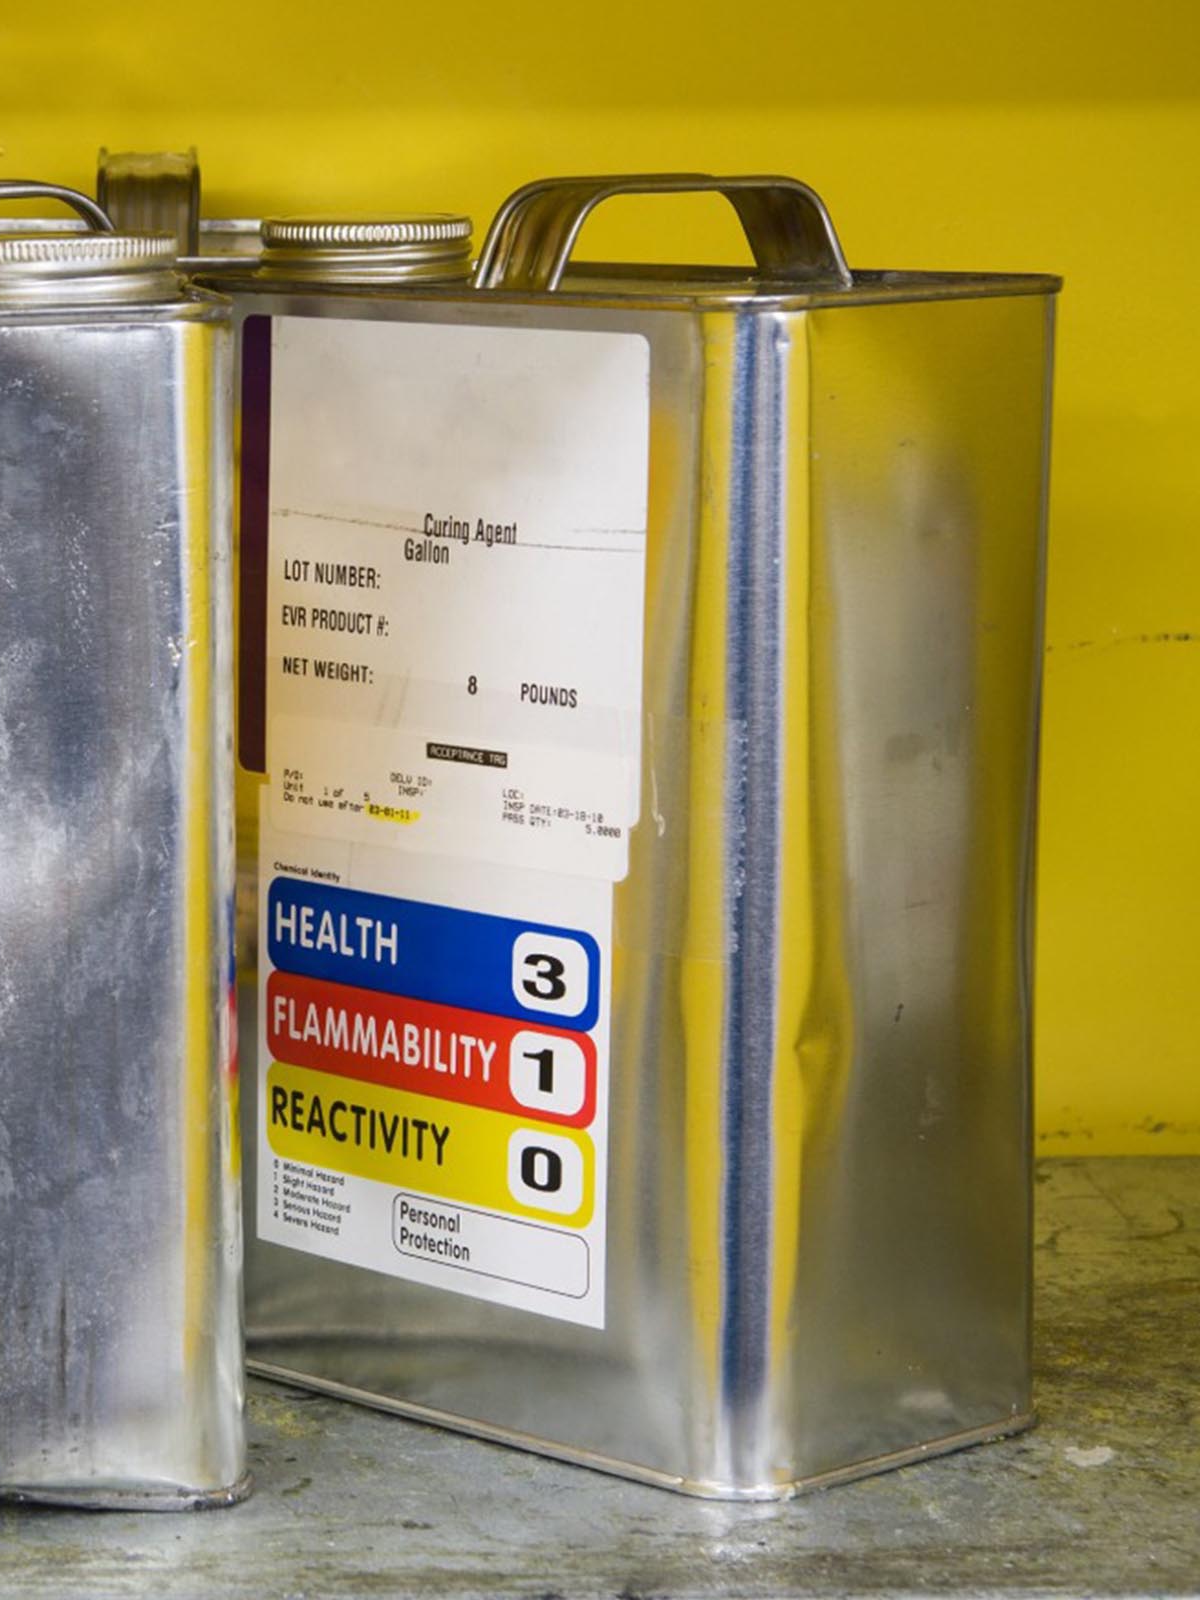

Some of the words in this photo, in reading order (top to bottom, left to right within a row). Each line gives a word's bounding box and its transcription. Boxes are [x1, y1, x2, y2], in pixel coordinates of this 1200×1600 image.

[424, 513, 470, 545] Curing
[475, 518, 518, 547] Agent
[404, 538, 450, 564] Gallon
[284, 559, 310, 582] LOT
[314, 562, 381, 589] NUMBER:
[282, 604, 307, 627] EVR
[311, 608, 373, 635] PRODUCT
[282, 656, 308, 675] NET
[314, 659, 374, 684] WEIGHT:
[467, 675, 478, 695] 8
[520, 683, 577, 708] POUNDS
[429, 743, 485, 764] ACCEPTANCE
[489, 752, 506, 767] TAG
[283, 791, 295, 802] Do
[273, 861, 308, 876] Chemical
[310, 867, 340, 883] Identity
[274, 900, 398, 966] HEALTH
[521, 953, 567, 1001] 3
[273, 995, 497, 1083] FLAMMABILITY
[522, 1048, 554, 1094] 1
[271, 1085, 450, 1166] REACTIVITY
[520, 1145, 562, 1194] 0
[283, 1161, 314, 1177] Minimal
[315, 1169, 345, 1186] Hazard
[283, 1187, 320, 1205] Moderate
[321, 1197, 351, 1213] Hazard
[306, 1182, 335, 1196] Hazard
[283, 1199, 311, 1216] Serious
[312, 1207, 342, 1224] Hazard
[283, 1211, 309, 1227] Severe
[310, 1219, 340, 1236] Hazard
[399, 1200, 461, 1233] Personal
[399, 1226, 470, 1262] Protection
